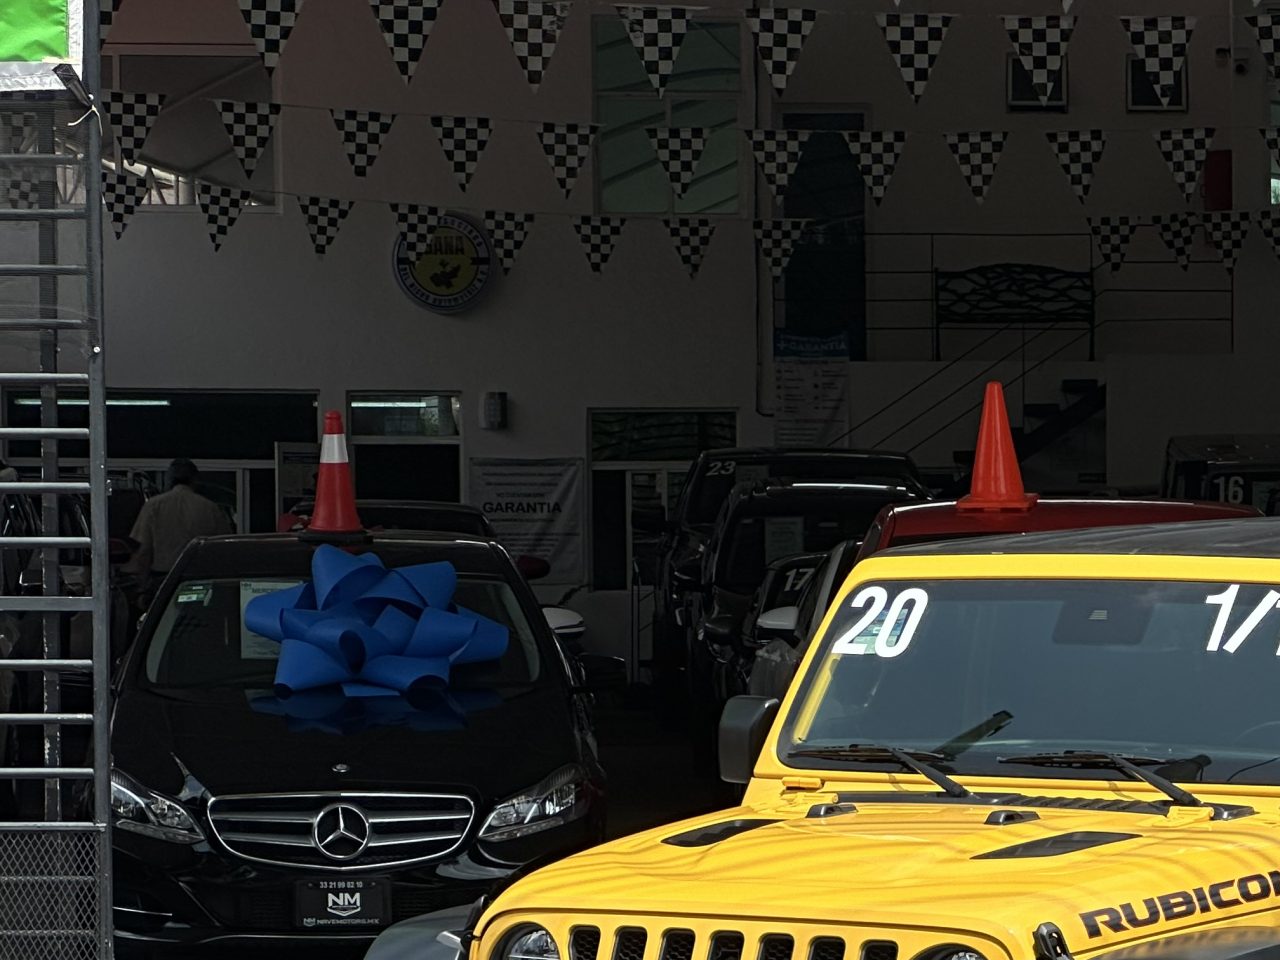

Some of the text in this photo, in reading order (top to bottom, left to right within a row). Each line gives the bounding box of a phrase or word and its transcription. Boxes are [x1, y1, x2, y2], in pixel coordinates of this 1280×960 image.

[704, 460, 737, 477] 23
[1212, 475, 1246, 504] 16
[483, 502, 562, 513] GARANTIA
[783, 567, 816, 592] 17
[832, 586, 929, 659] 20
[327, 892, 361, 908] NM
